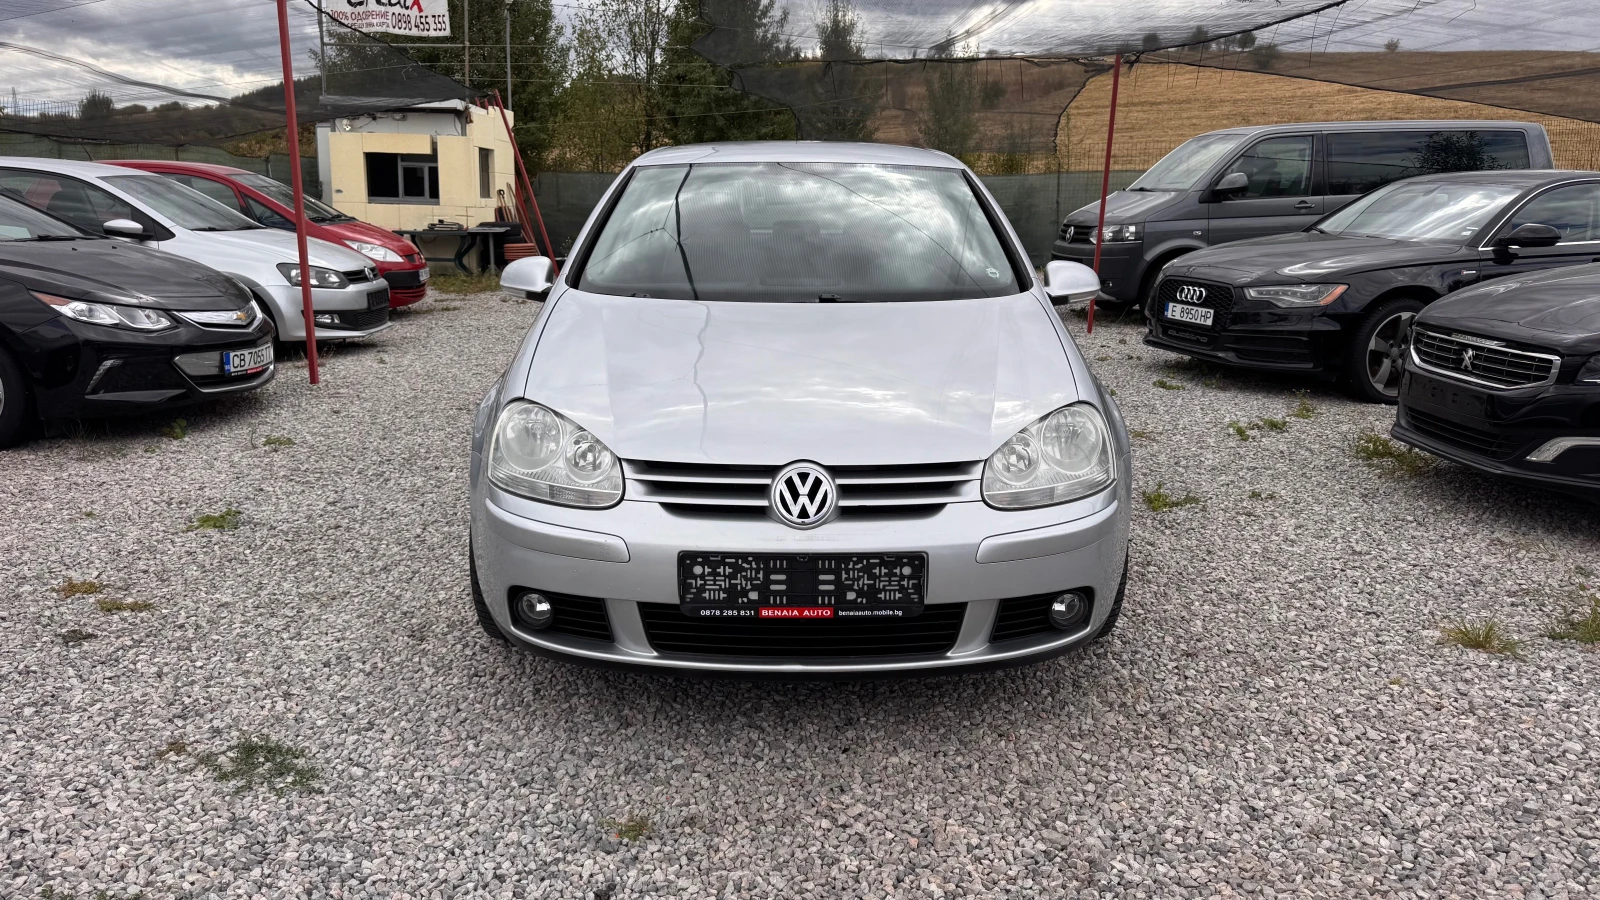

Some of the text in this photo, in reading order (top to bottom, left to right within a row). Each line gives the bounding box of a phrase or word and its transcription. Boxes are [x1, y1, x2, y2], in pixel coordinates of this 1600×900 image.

[391, 12, 412, 31] 0898
[414, 14, 431, 32] 455
[431, 14, 447, 31] 355
[1171, 305, 1211, 322] E 8950 HP
[232, 353, 246, 369] CB
[248, 348, 264, 366] 7055
